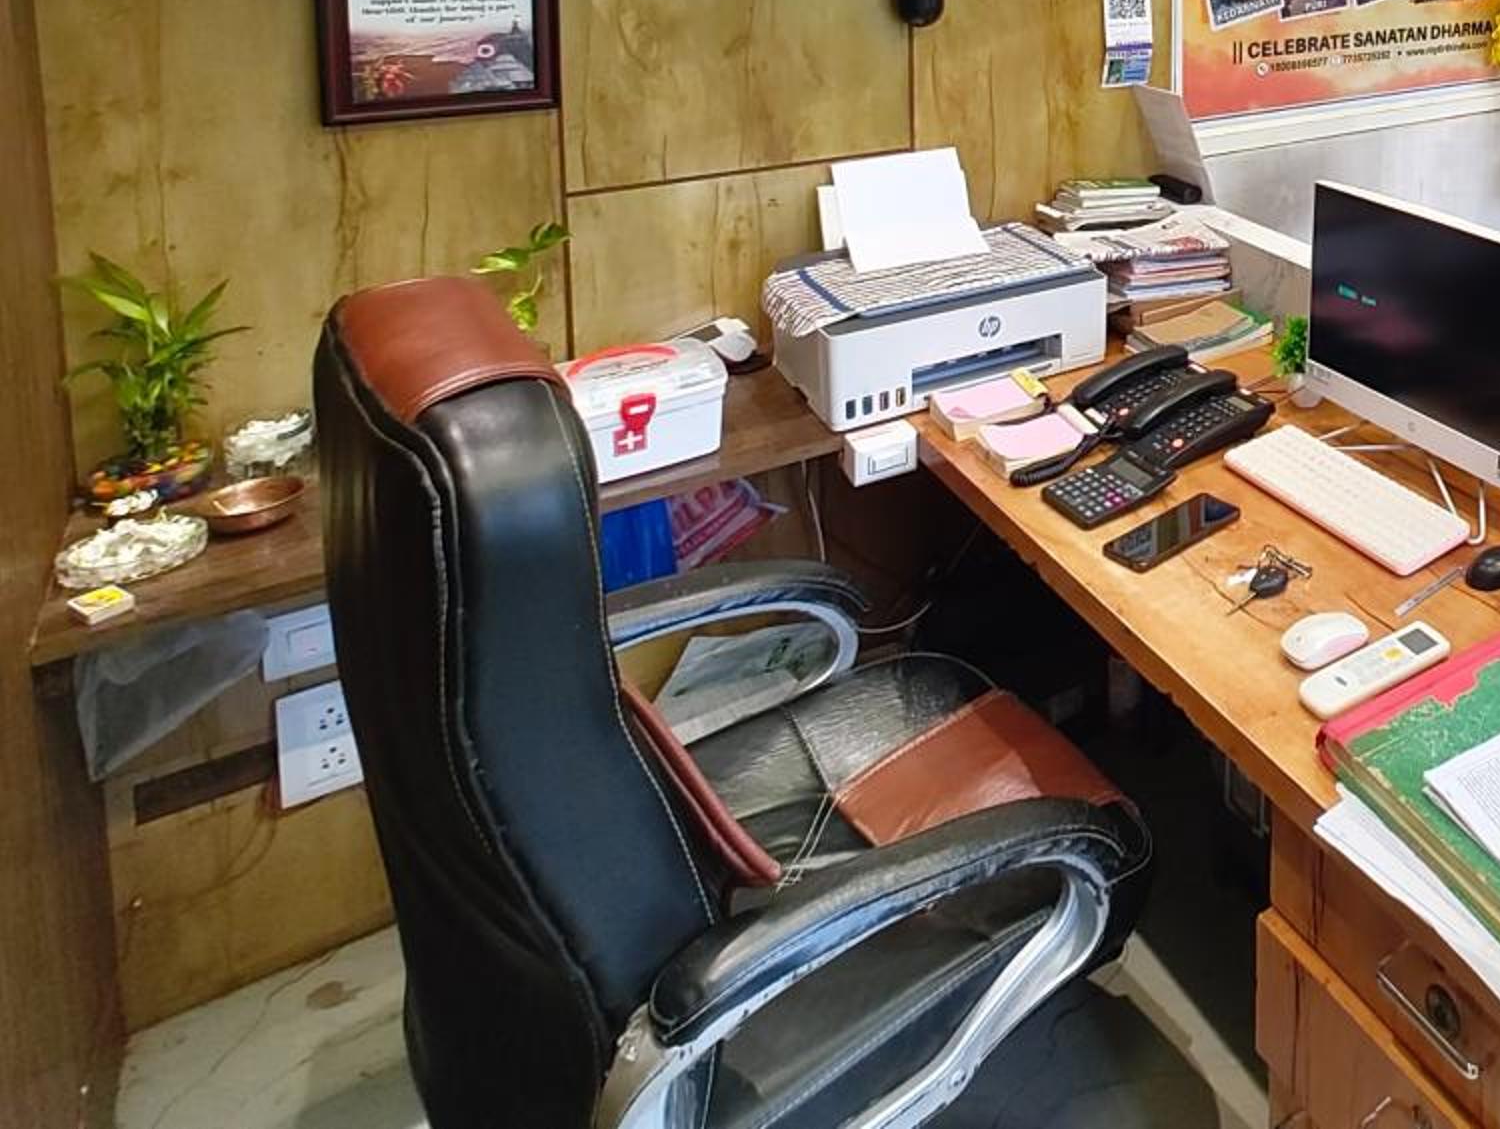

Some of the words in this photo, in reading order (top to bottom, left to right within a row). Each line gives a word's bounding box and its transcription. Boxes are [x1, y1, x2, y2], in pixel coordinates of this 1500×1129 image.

[1248, 34, 1351, 59] CELEBRATE
[1354, 27, 1427, 48] SANATAN
[1430, 20, 1494, 40] DHARMA
[979, 316, 1001, 338] hp
